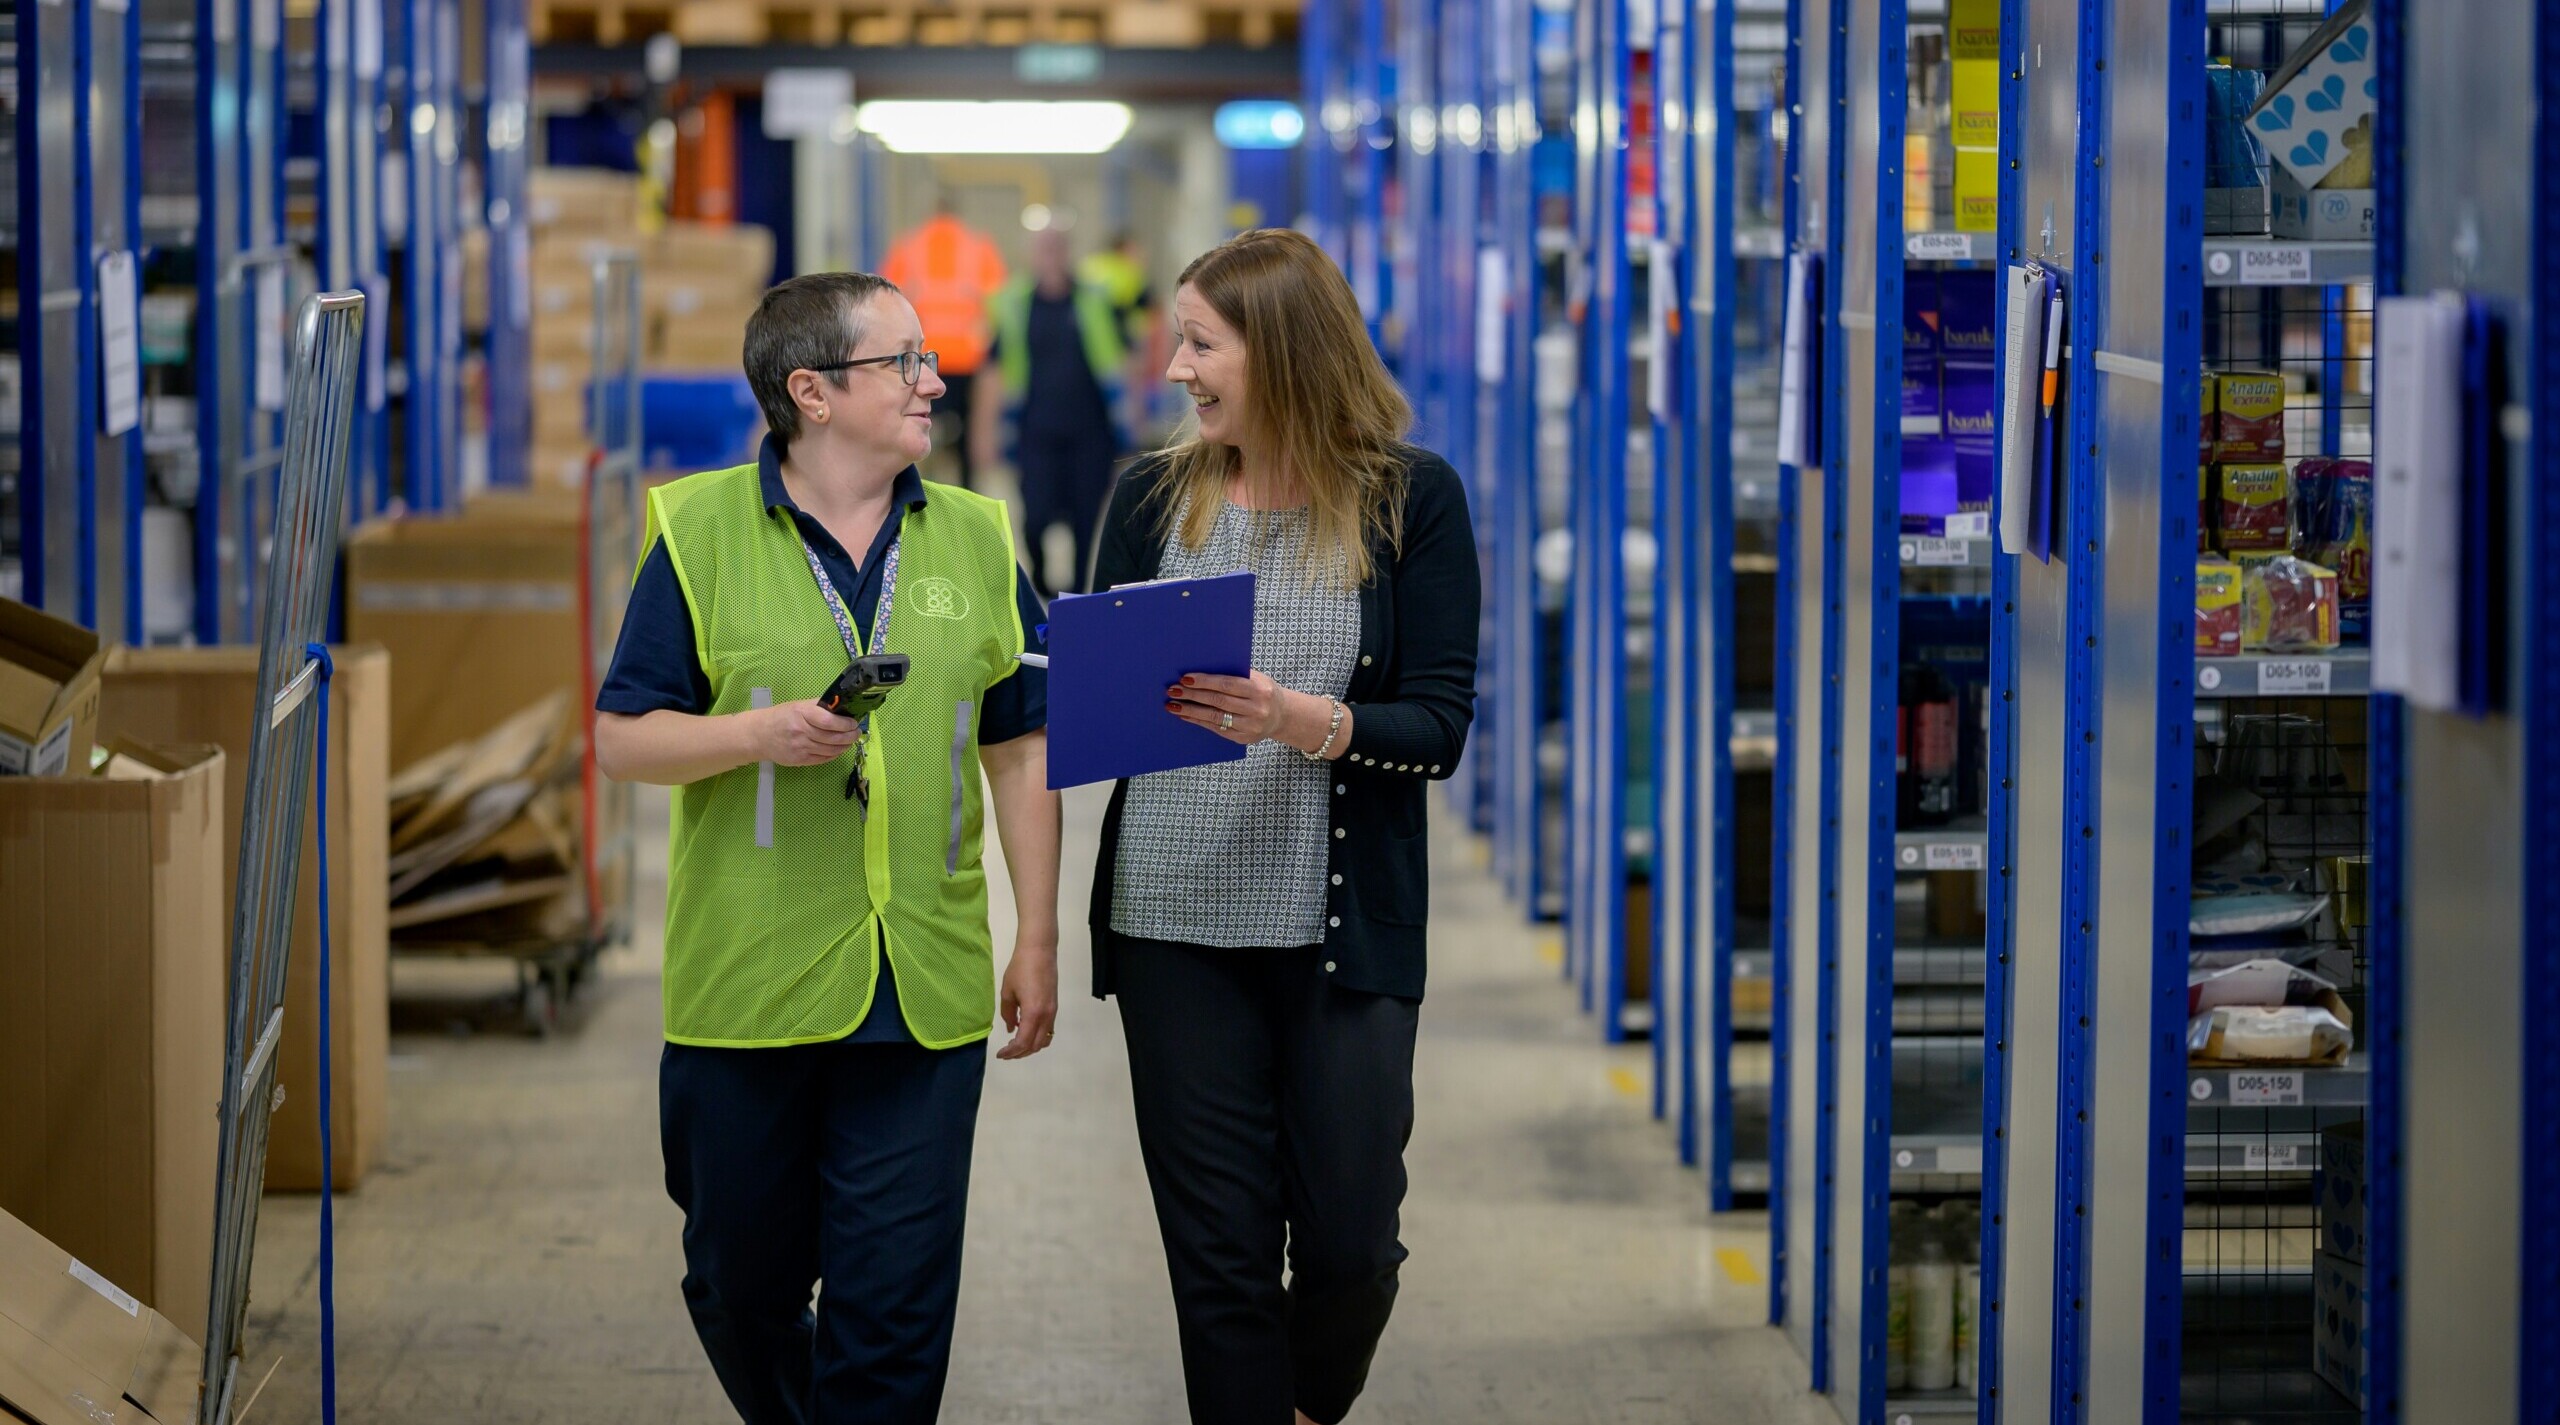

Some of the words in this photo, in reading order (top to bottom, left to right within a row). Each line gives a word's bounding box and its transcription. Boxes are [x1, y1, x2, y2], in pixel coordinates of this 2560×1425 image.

[2328, 200, 2345, 212] 70
[1921, 236, 1963, 248] E05-050
[2246, 251, 2302, 266] D05-050
[2227, 381, 2278, 395] Anadin
[2232, 396, 2272, 406] EXTRA
[2230, 469, 2279, 482] Anadin
[2235, 483, 2273, 494] EXTRA
[1921, 540, 1962, 552] E05-100
[2265, 664, 2321, 679] D05-100
[1932, 846, 1973, 858] E05-150
[2237, 1076, 2293, 1090] D05-150
[2250, 1145, 2290, 1158] E0-202
